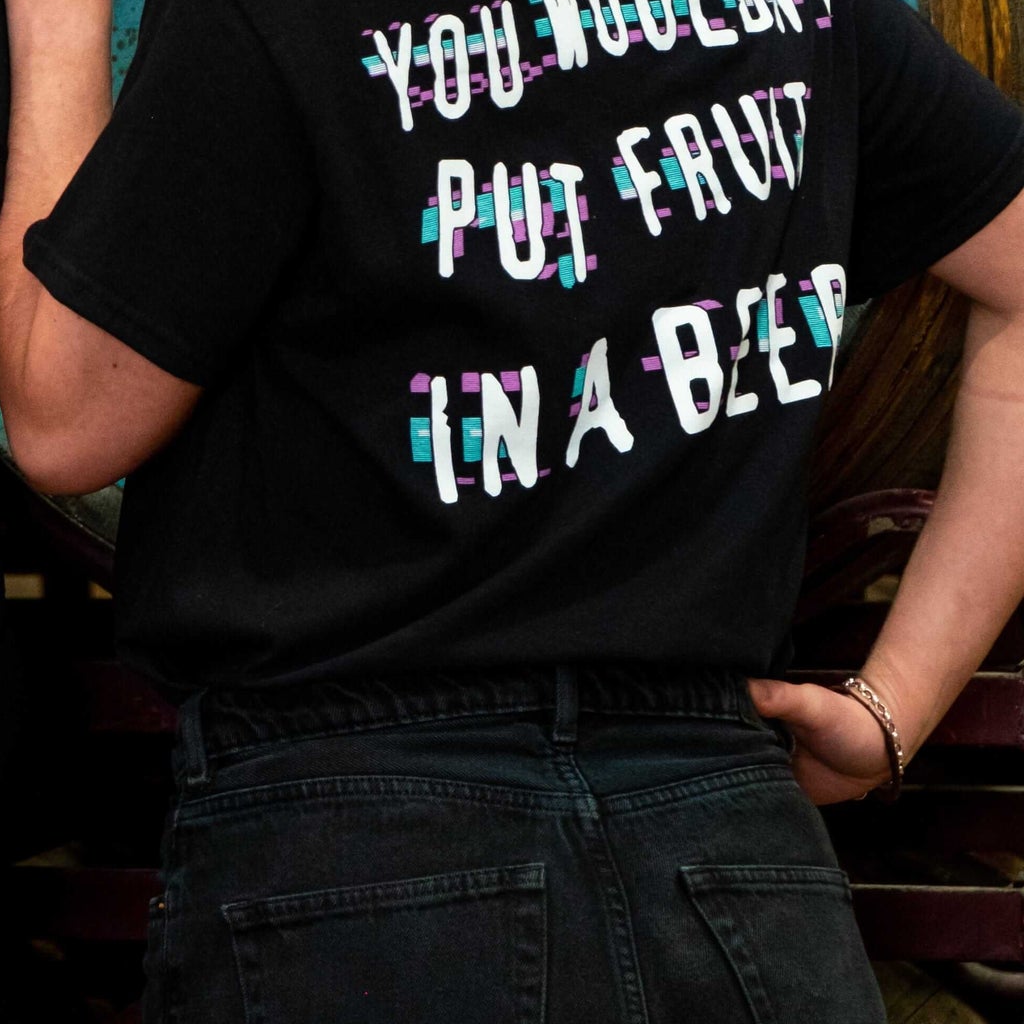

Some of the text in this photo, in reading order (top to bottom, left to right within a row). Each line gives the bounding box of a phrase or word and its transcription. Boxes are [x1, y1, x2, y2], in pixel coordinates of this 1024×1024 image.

[365, 0, 524, 132] YOU
[423, 81, 811, 288] PUT FRUIT
[413, 365, 549, 503] IN
[567, 337, 634, 468] A
